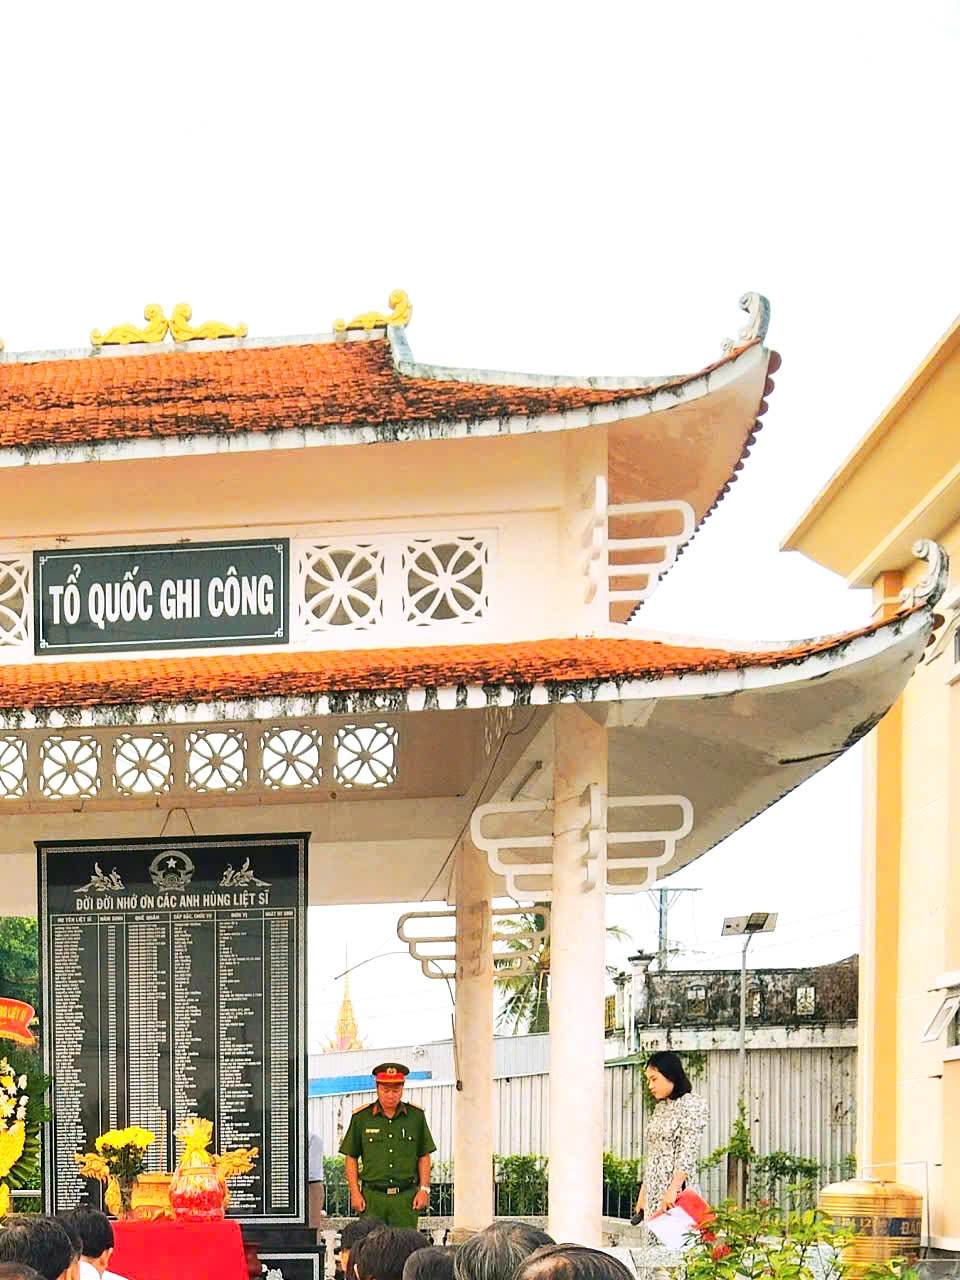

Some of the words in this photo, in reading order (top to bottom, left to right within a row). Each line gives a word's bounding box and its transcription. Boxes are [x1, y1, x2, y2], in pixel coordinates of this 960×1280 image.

[48, 563, 81, 625] TỔ
[89, 566, 153, 629] QUỐC
[160, 578, 201, 620] GHI
[208, 566, 274, 617] CÔNG
[76, 894, 94, 911] ĐỜI
[96, 893, 114, 910] ĐỜI
[116, 893, 138, 910] NHỚ
[140, 894, 155, 909] ƠN
[156, 892, 177, 909] CÁC
[179, 894, 200, 908] ANH
[203, 890, 231, 907] HÙNG
[233, 889, 256, 908] LIỆT
[258, 889, 270, 905] SĨ
